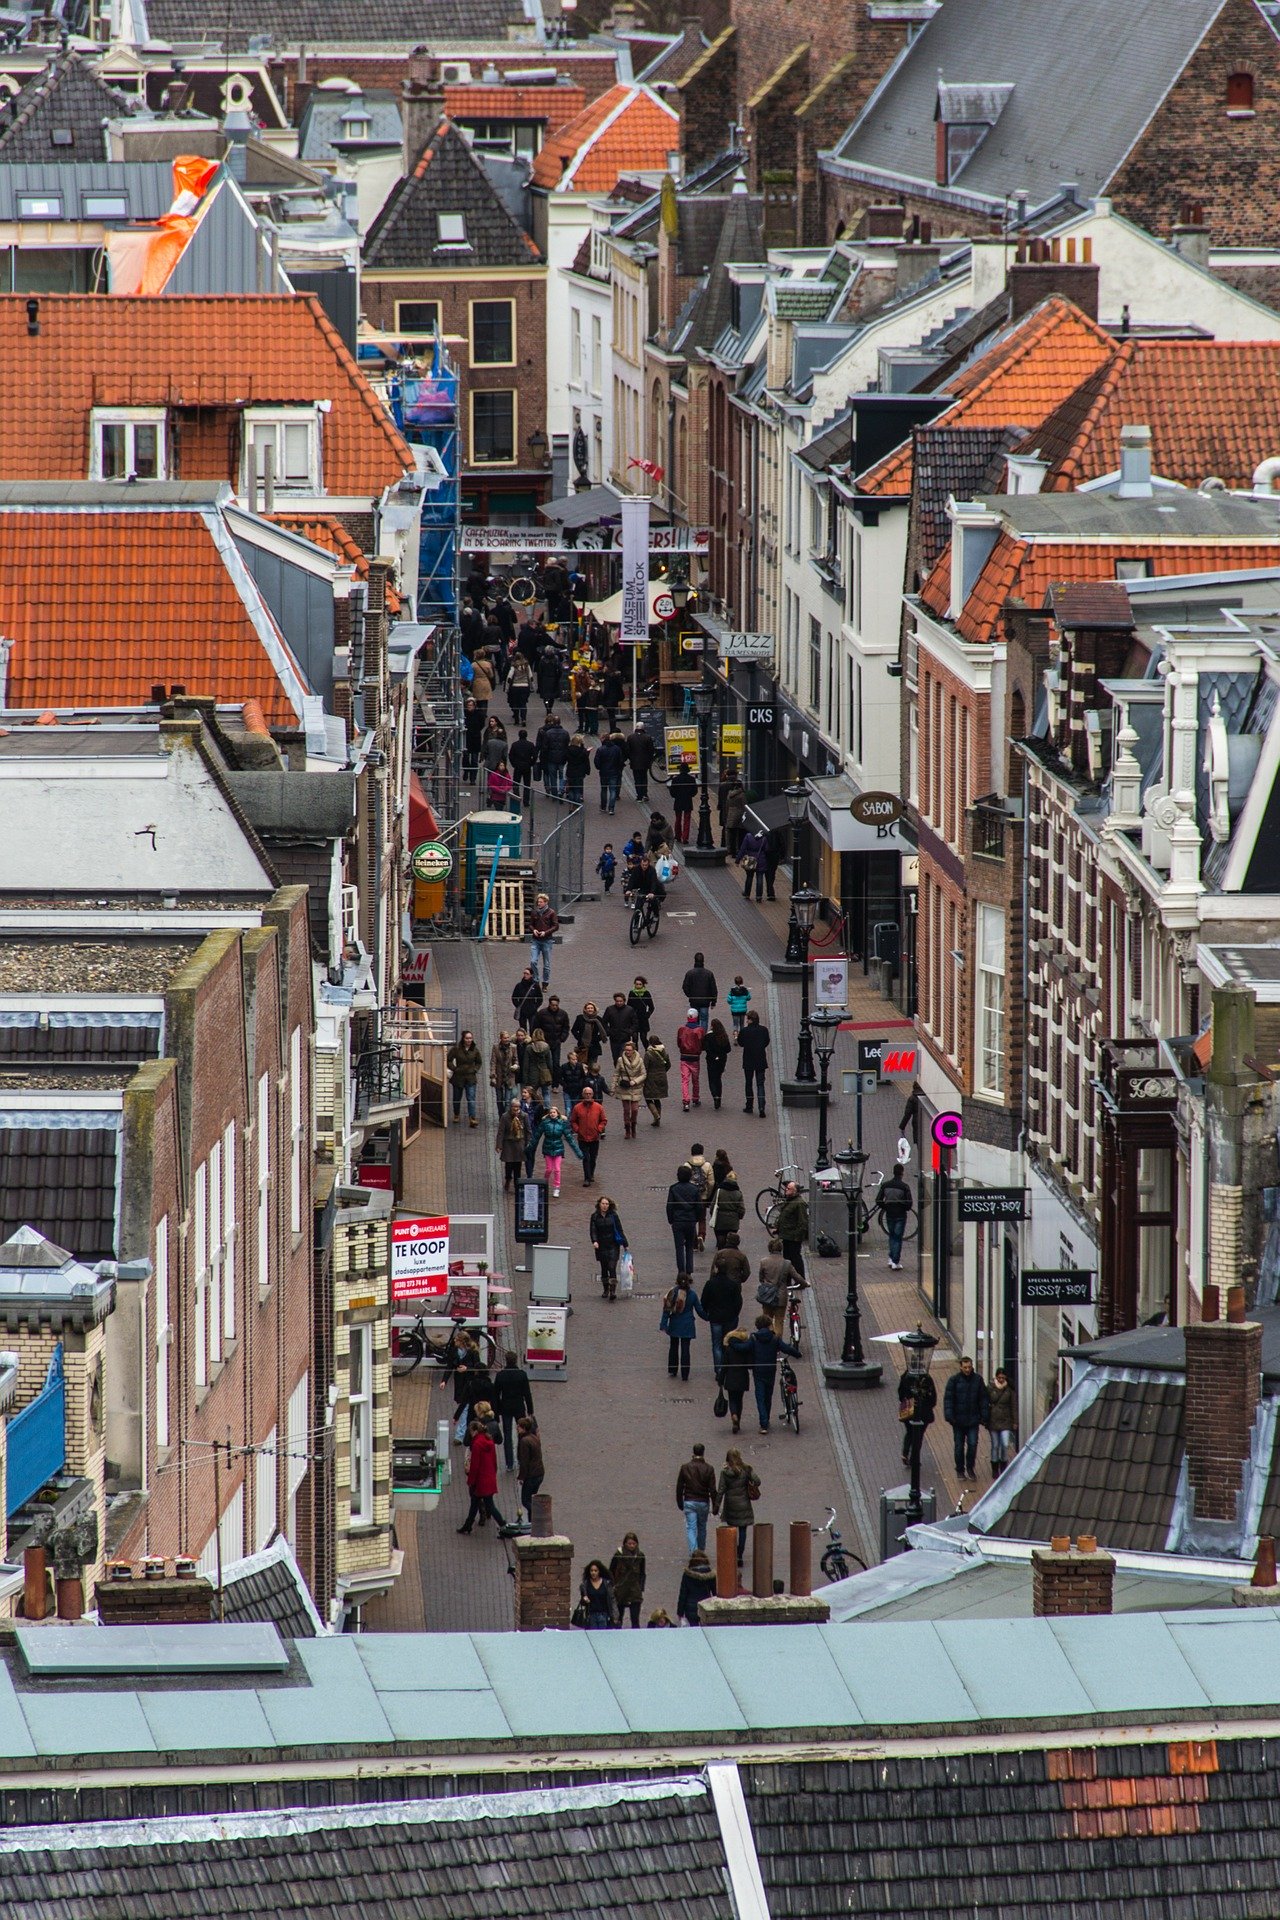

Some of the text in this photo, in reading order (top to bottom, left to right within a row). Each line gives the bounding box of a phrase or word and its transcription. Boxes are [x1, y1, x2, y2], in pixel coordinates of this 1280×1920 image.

[464, 538, 557, 547] IN DE ROARING TWENTIES
[624, 578, 635, 635] MUSEUM
[725, 635, 771, 650] JAZZ
[750, 709, 773, 723] CKS
[667, 729, 696, 740] ZORG
[862, 801, 893, 816] SABON
[415, 859, 449, 867] Heineken
[401, 973, 424, 981] MAN
[864, 1047, 881, 1058] Lee
[963, 1201, 1021, 1214] SISSY-BOY
[394, 1224, 447, 1236] PUNT MAKELAARS
[395, 1240, 446, 1257] TE KOOP
[395, 1265, 446, 1276] stadsappartement
[1027, 1284, 1087, 1298] SISSY-BOY
